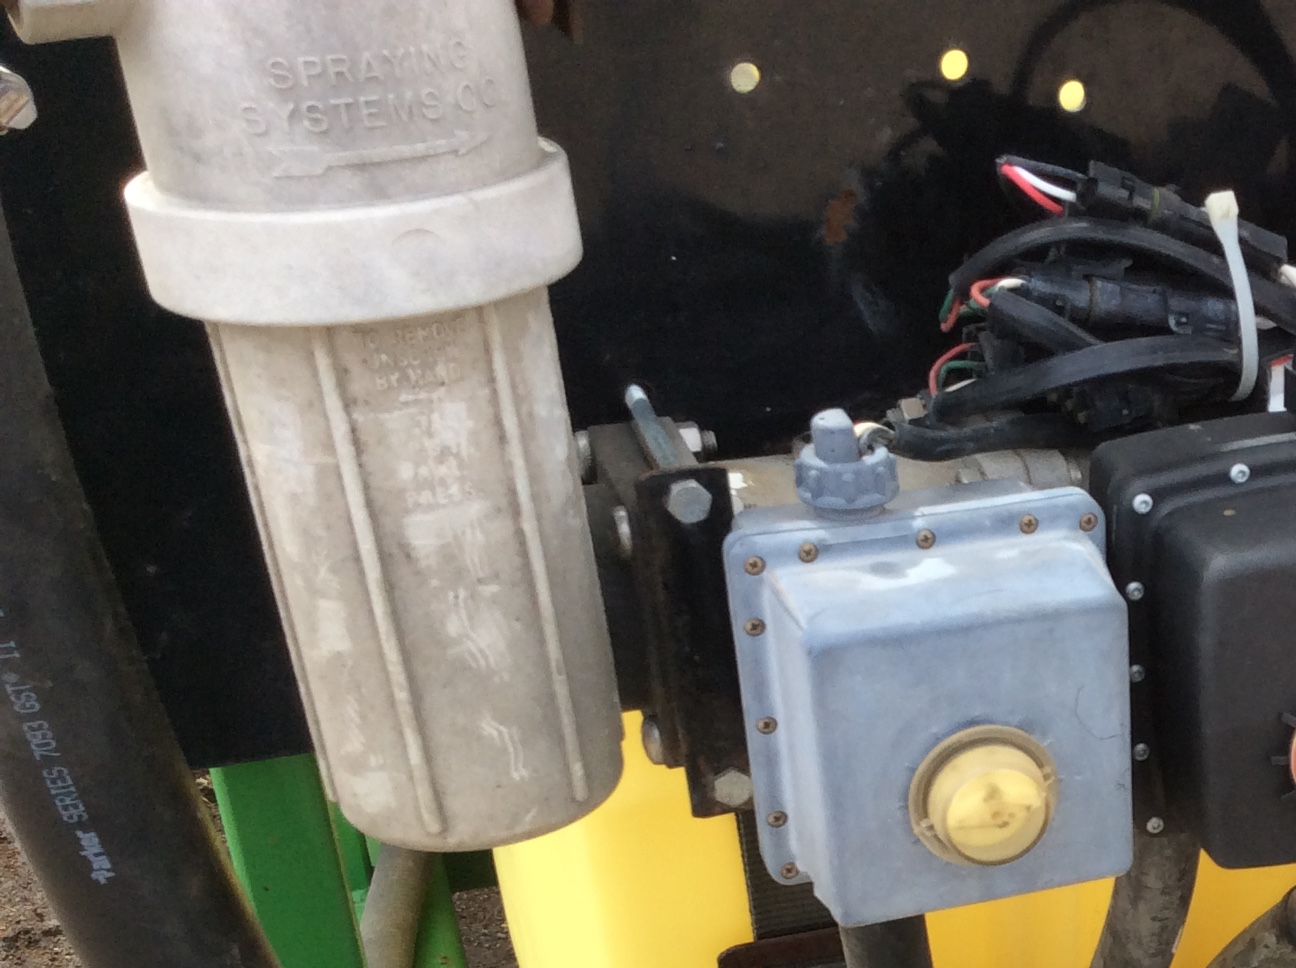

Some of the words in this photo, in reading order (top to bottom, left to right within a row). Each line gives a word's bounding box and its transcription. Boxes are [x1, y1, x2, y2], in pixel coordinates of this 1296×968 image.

[268, 40, 467, 88] SPRAYING
[241, 89, 442, 135] SYSTEMS
[22, 719, 61, 761] 7093
[41, 767, 87, 824] SERIES
